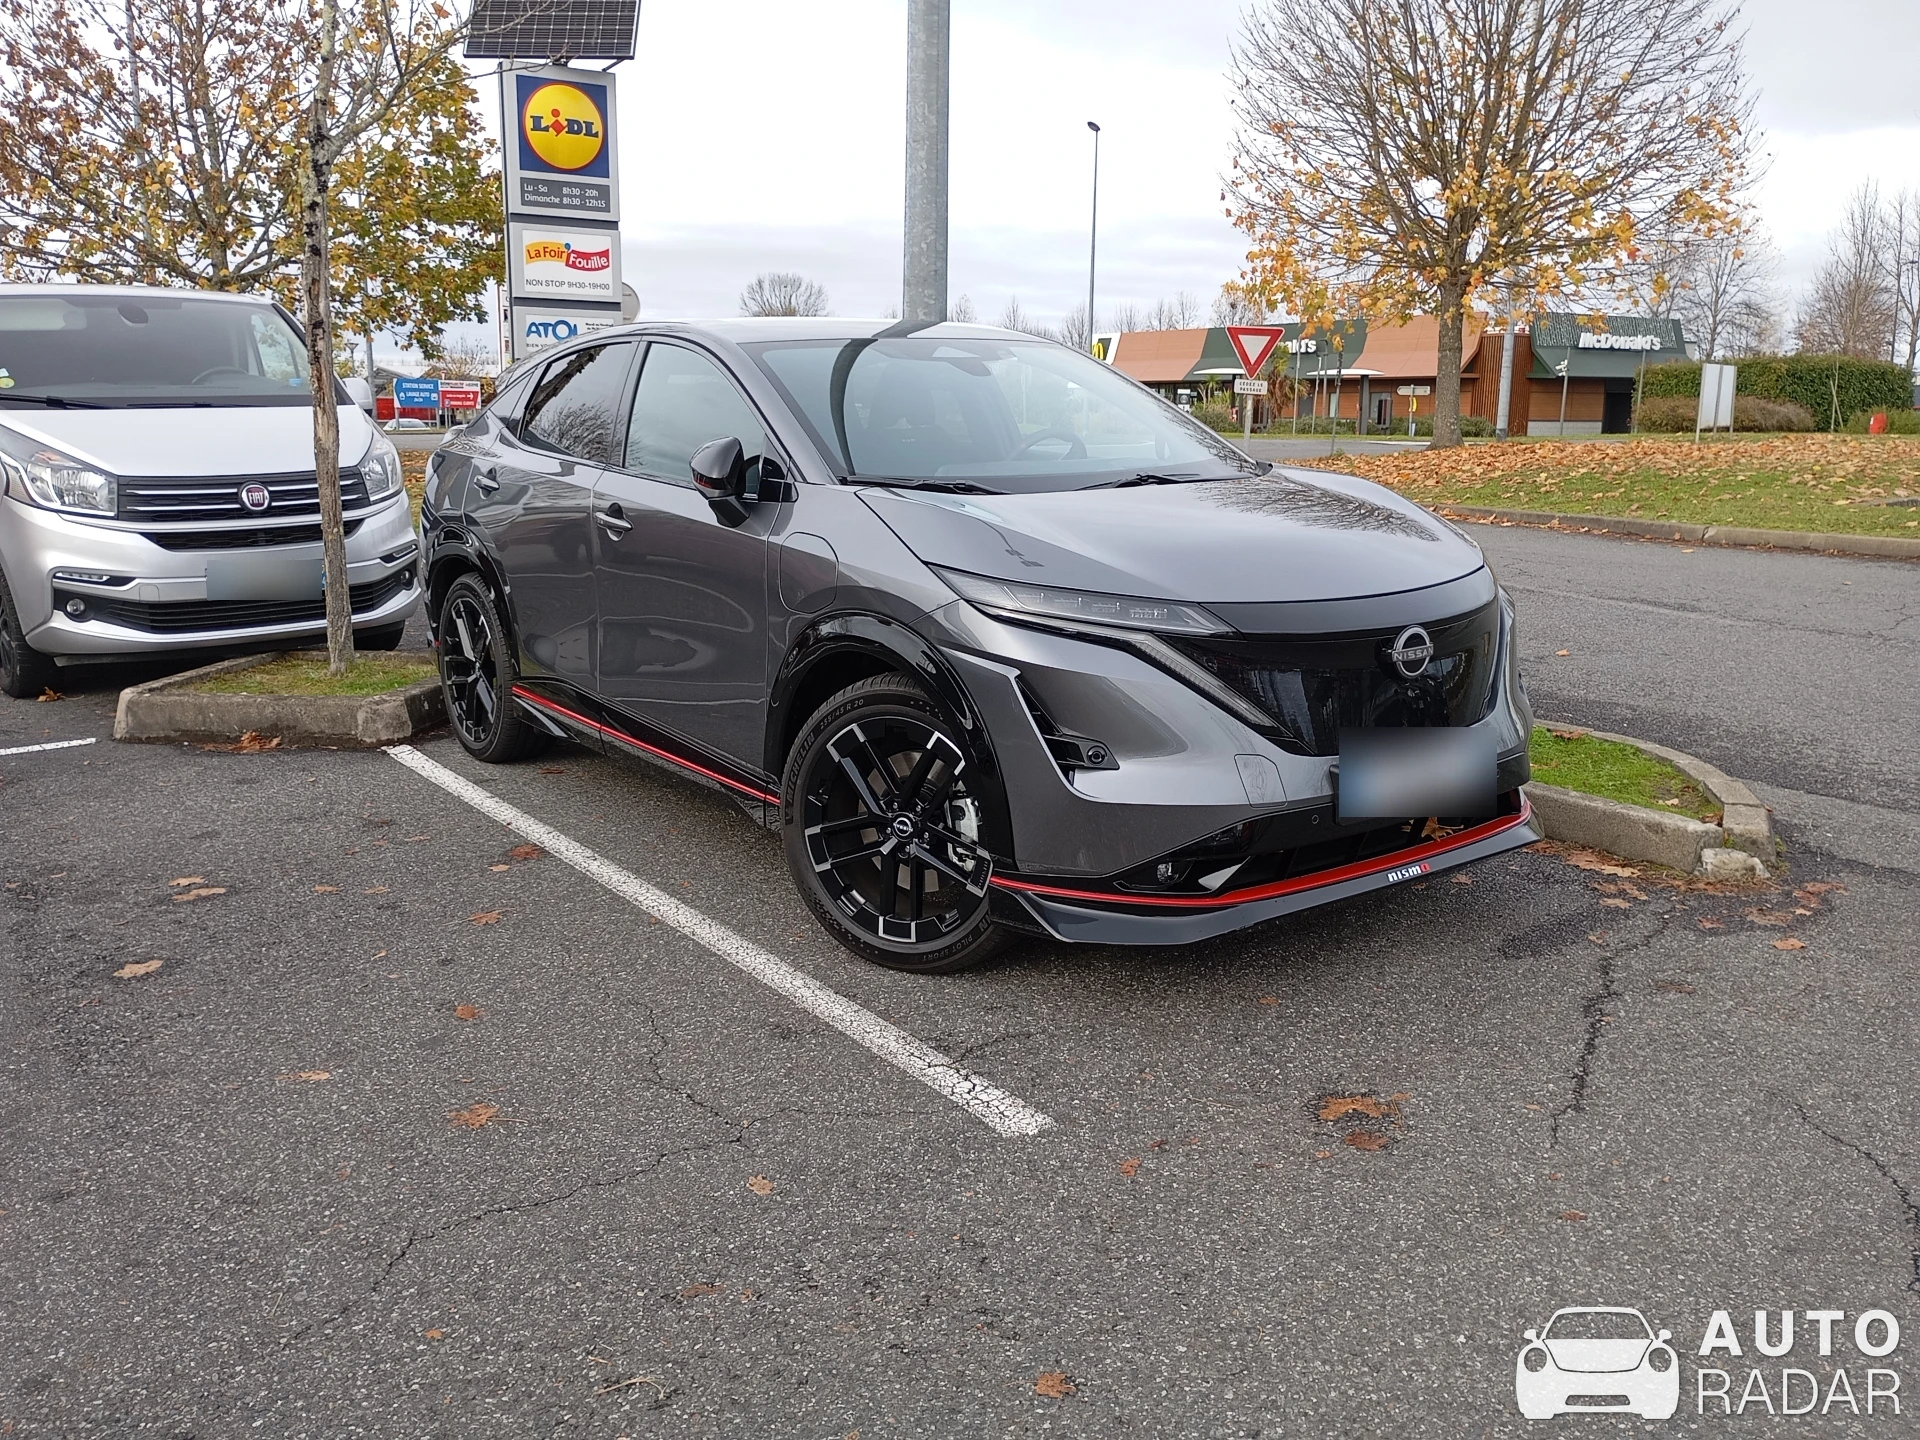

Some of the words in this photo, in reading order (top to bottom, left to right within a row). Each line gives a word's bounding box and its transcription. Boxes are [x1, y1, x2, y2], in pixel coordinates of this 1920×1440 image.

[530, 108, 599, 138] LIDL
[524, 183, 533, 191] Lu
[538, 185, 548, 193] Sa
[562, 187, 580, 195] 8h30
[585, 189, 599, 197] 20h
[524, 193, 560, 204] Dimanche
[562, 197, 580, 205] 8h30
[585, 199, 606, 208] 12h15
[527, 249, 542, 260] La
[569, 253, 609, 269] Fouille
[525, 279, 543, 287] NON
[544, 280, 566, 288] STOP
[567, 281, 610, 290] 9H30-19H00
[1579, 332, 1661, 351] McDonald's
[248, 492, 264, 504] FIAT
[1394, 646, 1433, 661] NISSAN
[854, 699, 864, 707] 20
[786, 732, 815, 804] MICHELIN
[1387, 863, 1430, 882] nismo
[952, 934, 973, 953] PILOT
[923, 948, 949, 960] SPORT
